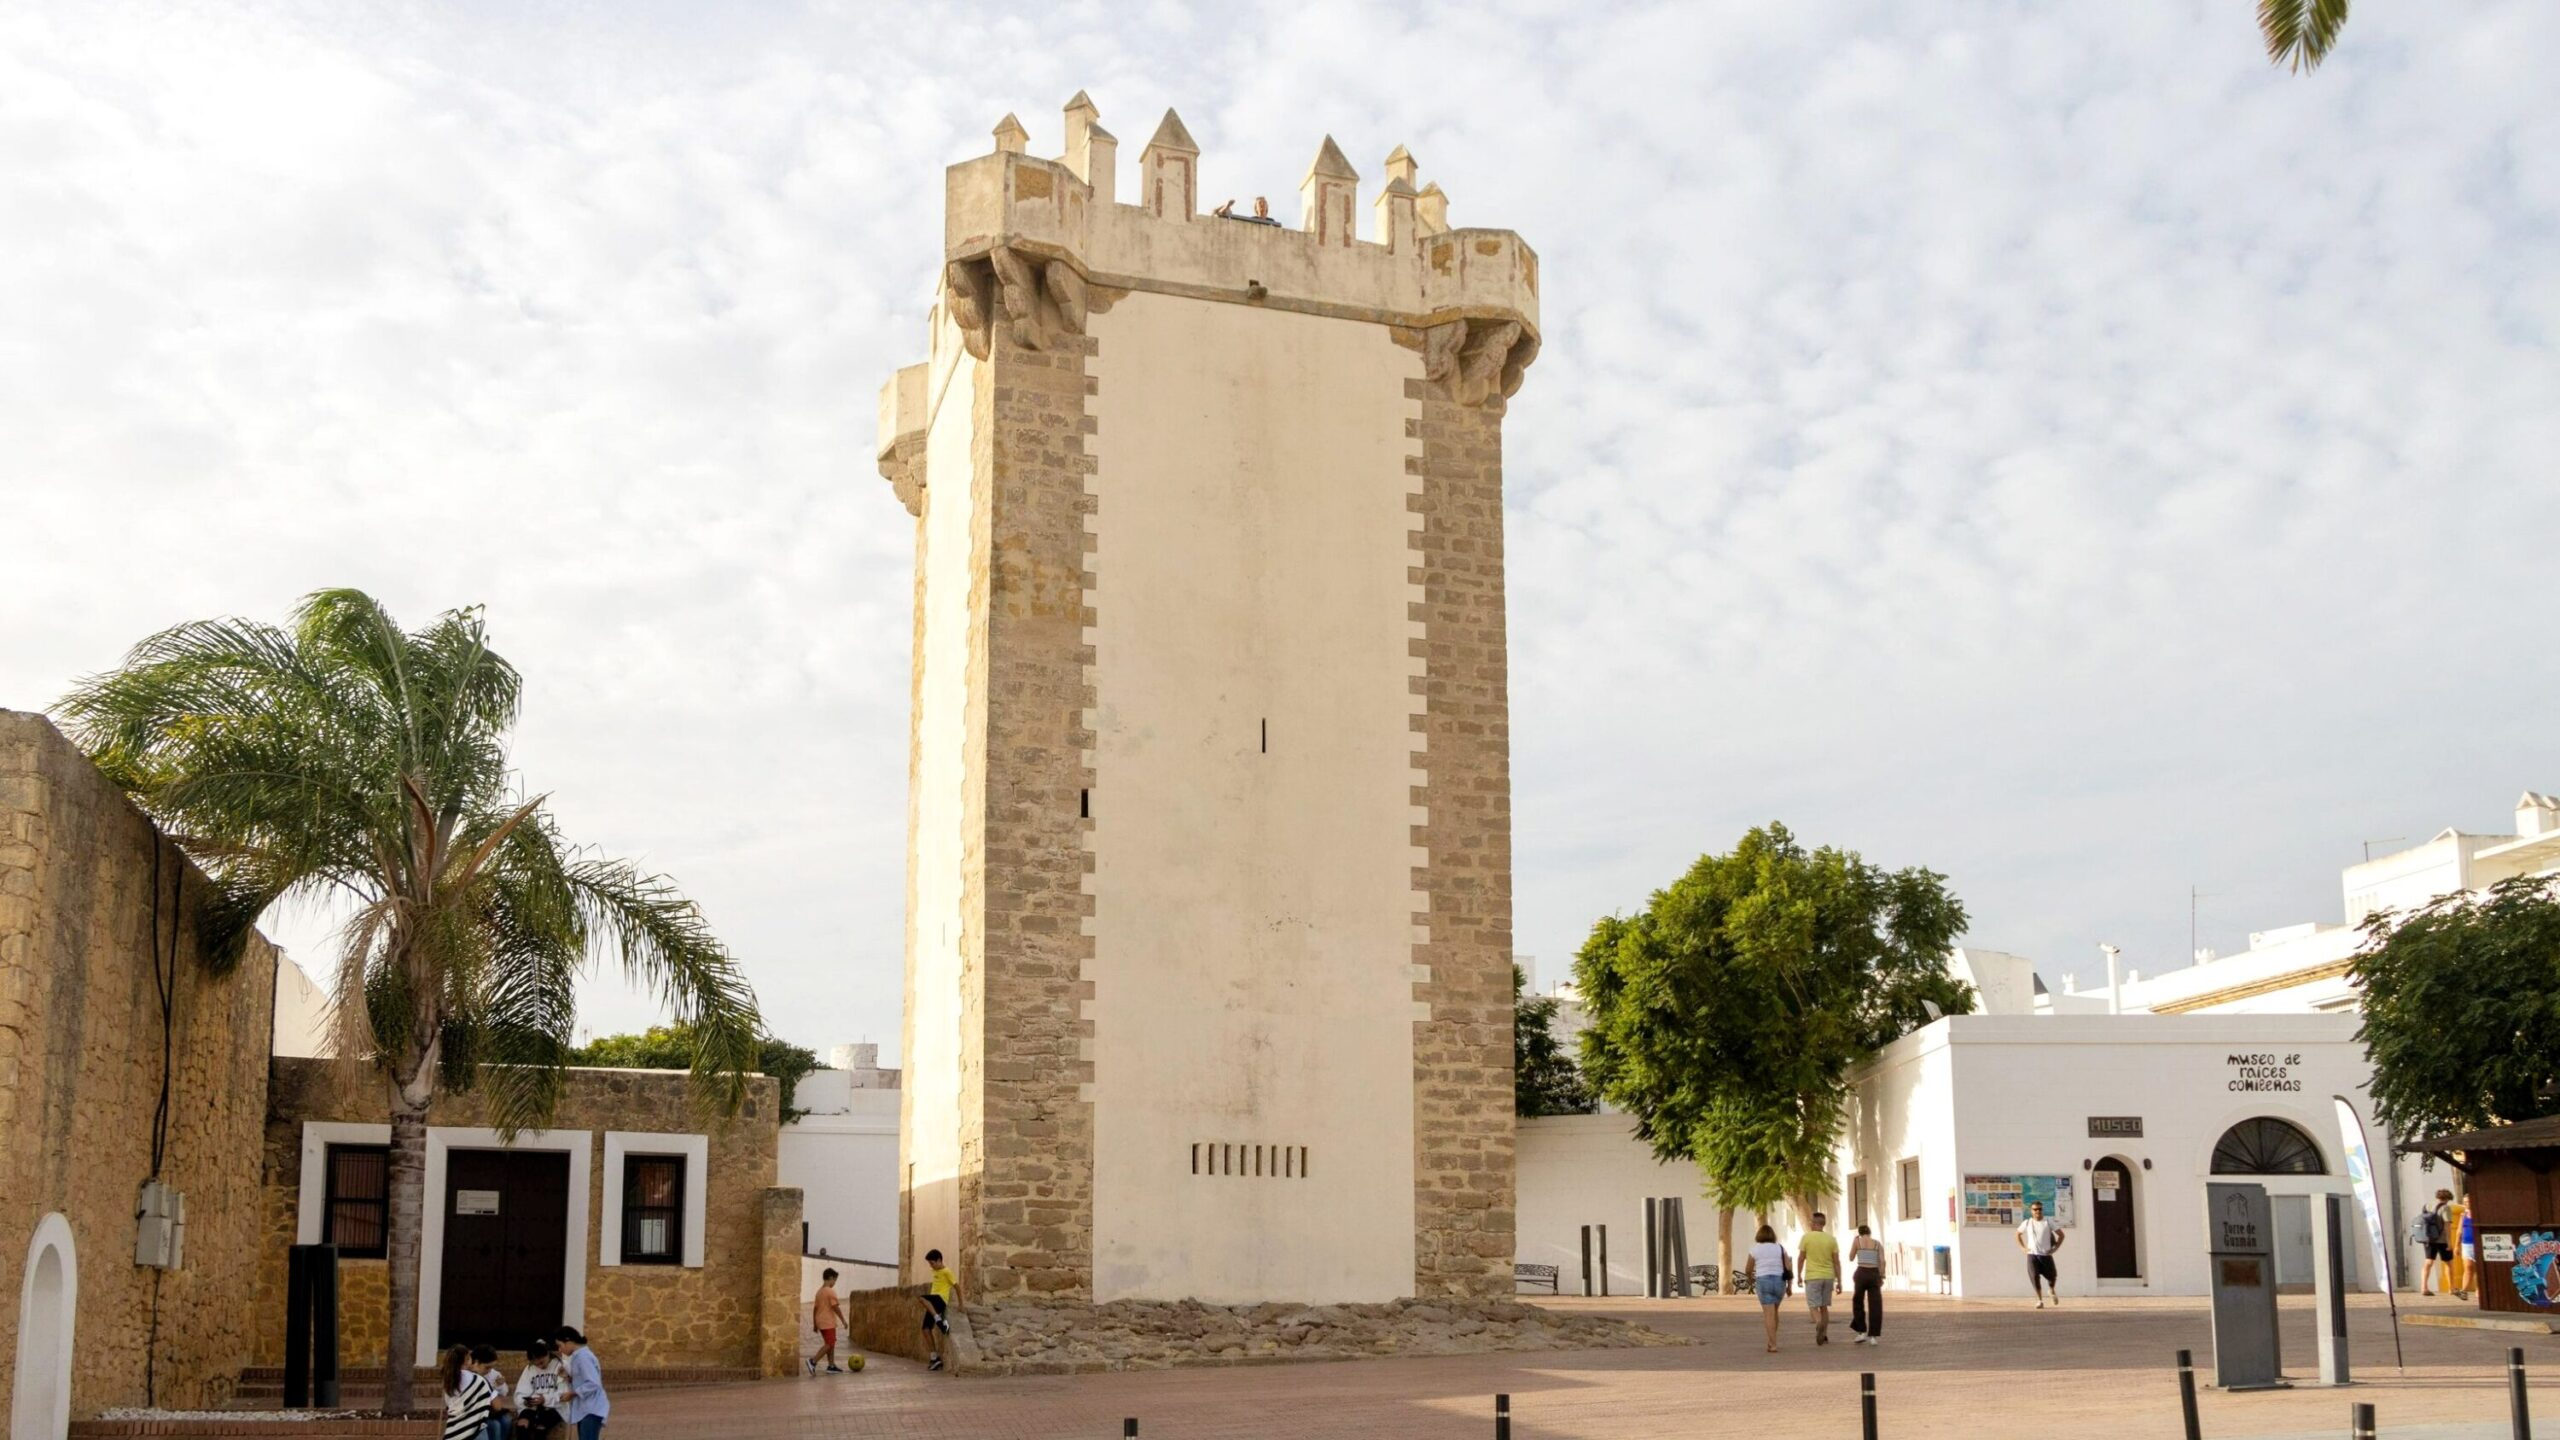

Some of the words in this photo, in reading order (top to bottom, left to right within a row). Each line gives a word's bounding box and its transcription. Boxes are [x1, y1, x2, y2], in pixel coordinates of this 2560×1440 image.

[2284, 1053, 2301, 1066] de
[2090, 1119, 2142, 1131] MUSEO
[2223, 1221, 2245, 1235] Torre
[2246, 1222, 2256, 1235] de
